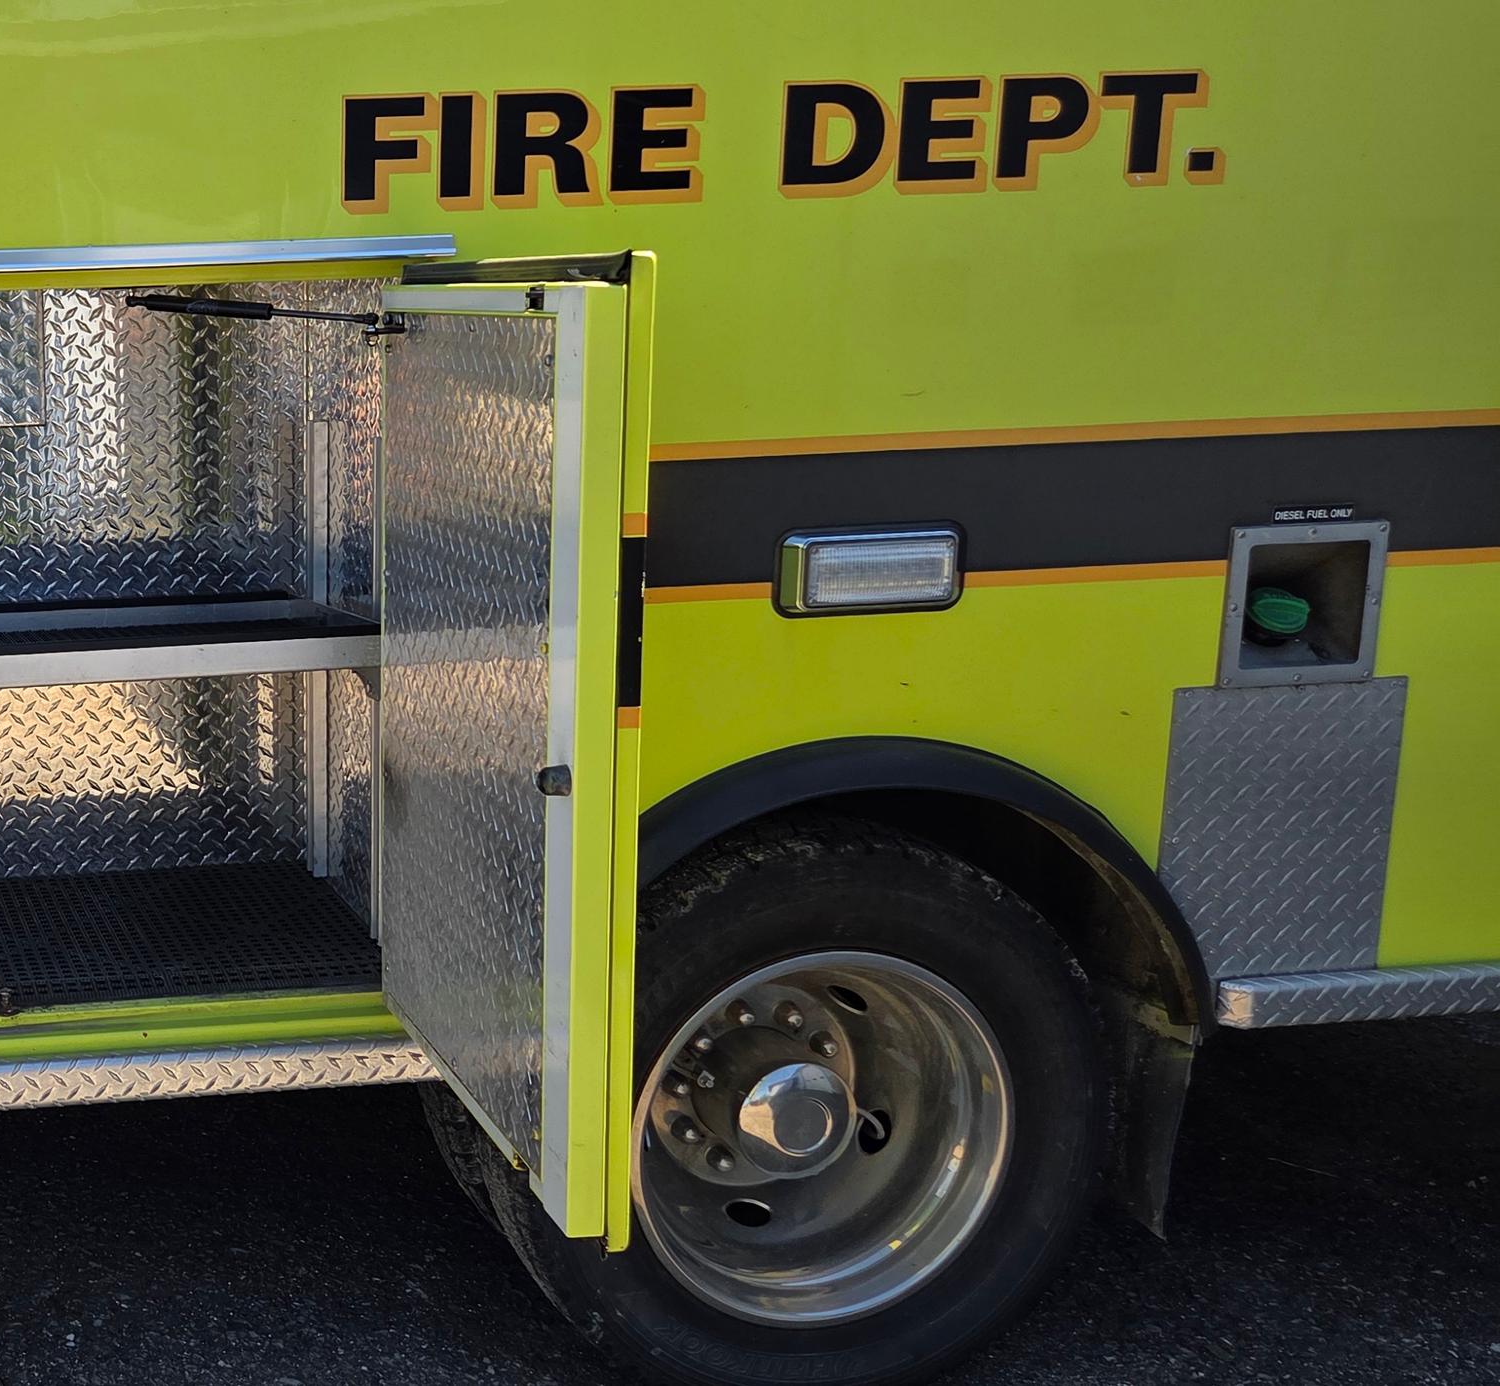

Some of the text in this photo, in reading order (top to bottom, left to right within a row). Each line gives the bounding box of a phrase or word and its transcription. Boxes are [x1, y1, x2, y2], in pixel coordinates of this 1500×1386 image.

[341, 68, 1226, 215] FIRE DEPT.
[1275, 509, 1353, 520] DIESEL FUEL ONLY
